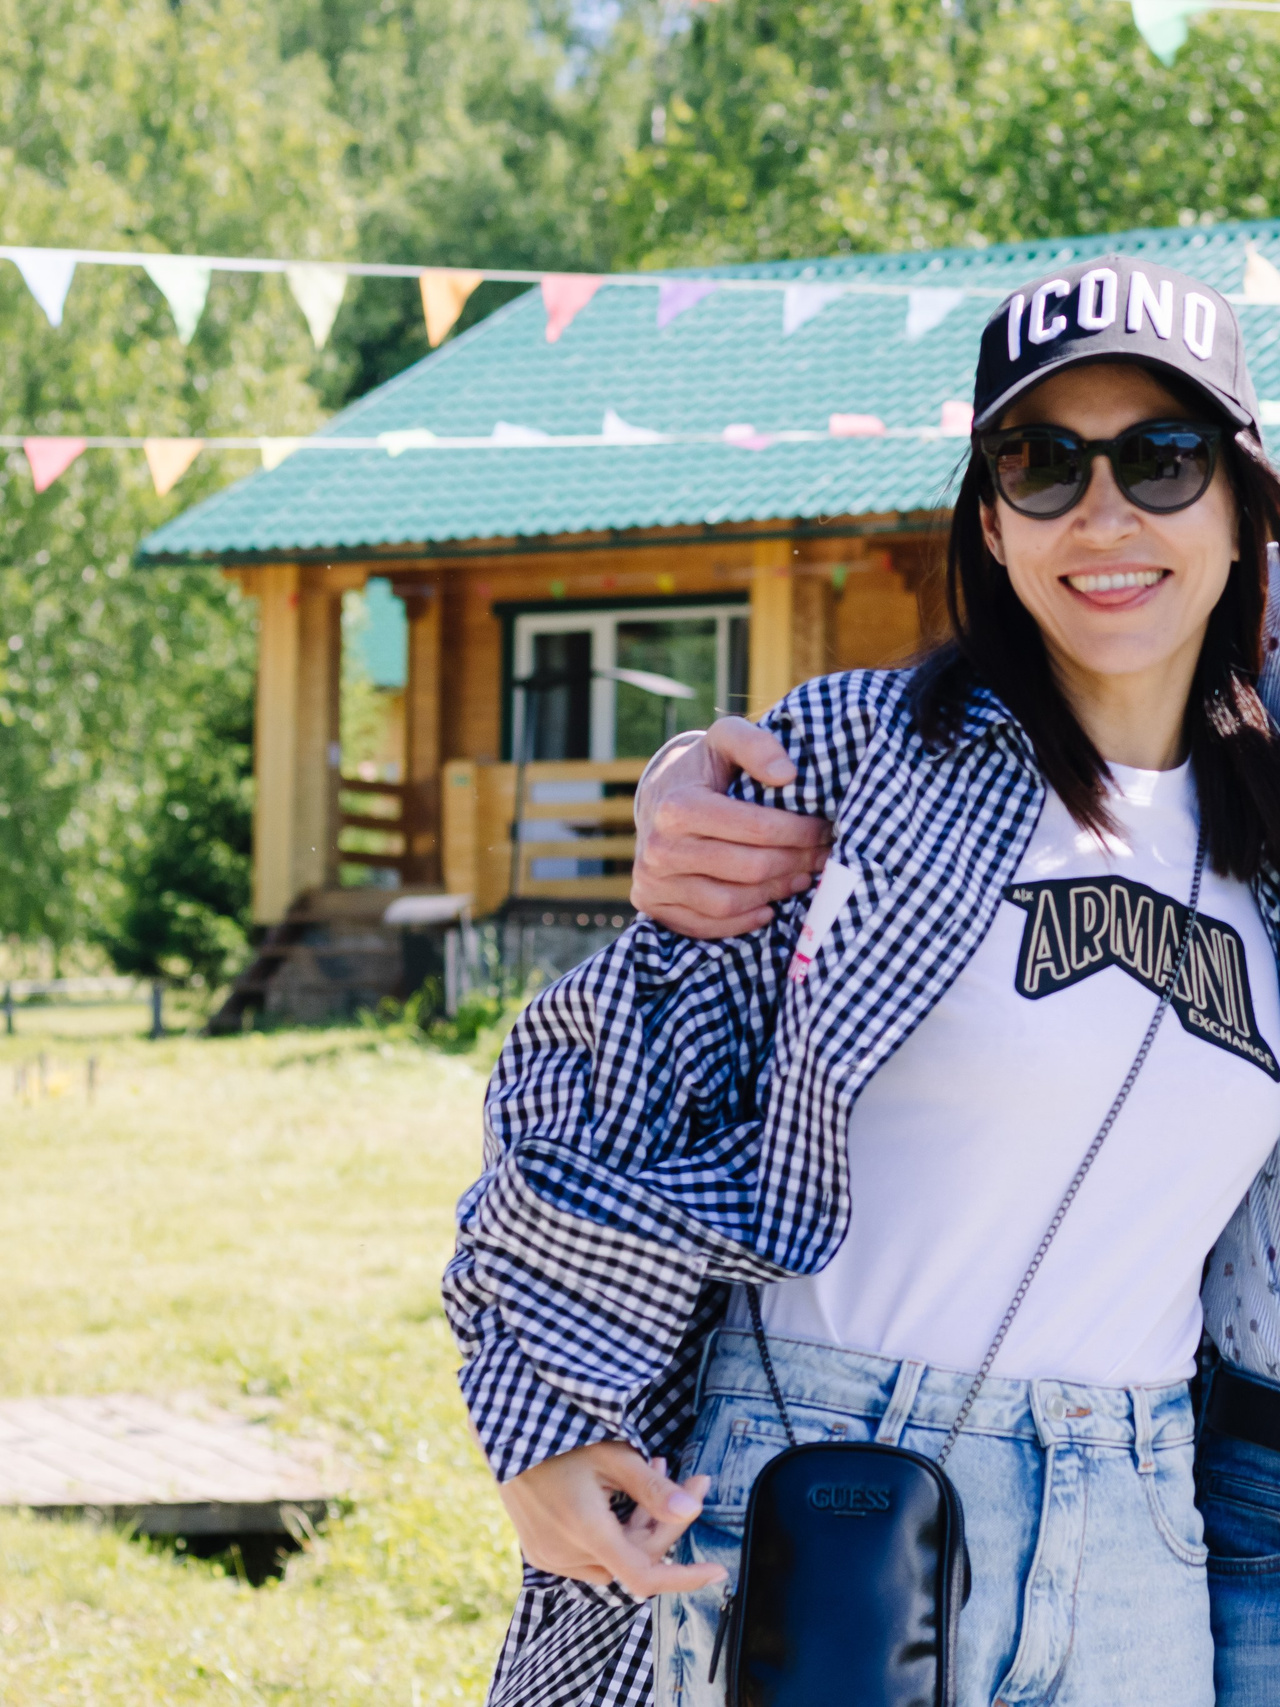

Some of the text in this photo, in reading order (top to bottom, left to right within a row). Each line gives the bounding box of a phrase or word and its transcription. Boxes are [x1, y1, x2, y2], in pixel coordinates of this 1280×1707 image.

[1007, 267, 1216, 362] ICONO
[1023, 884, 1250, 1038] ARMANI
[1188, 1007, 1275, 1071] EXCHANGE
[810, 1484, 891, 1511] GUESS
